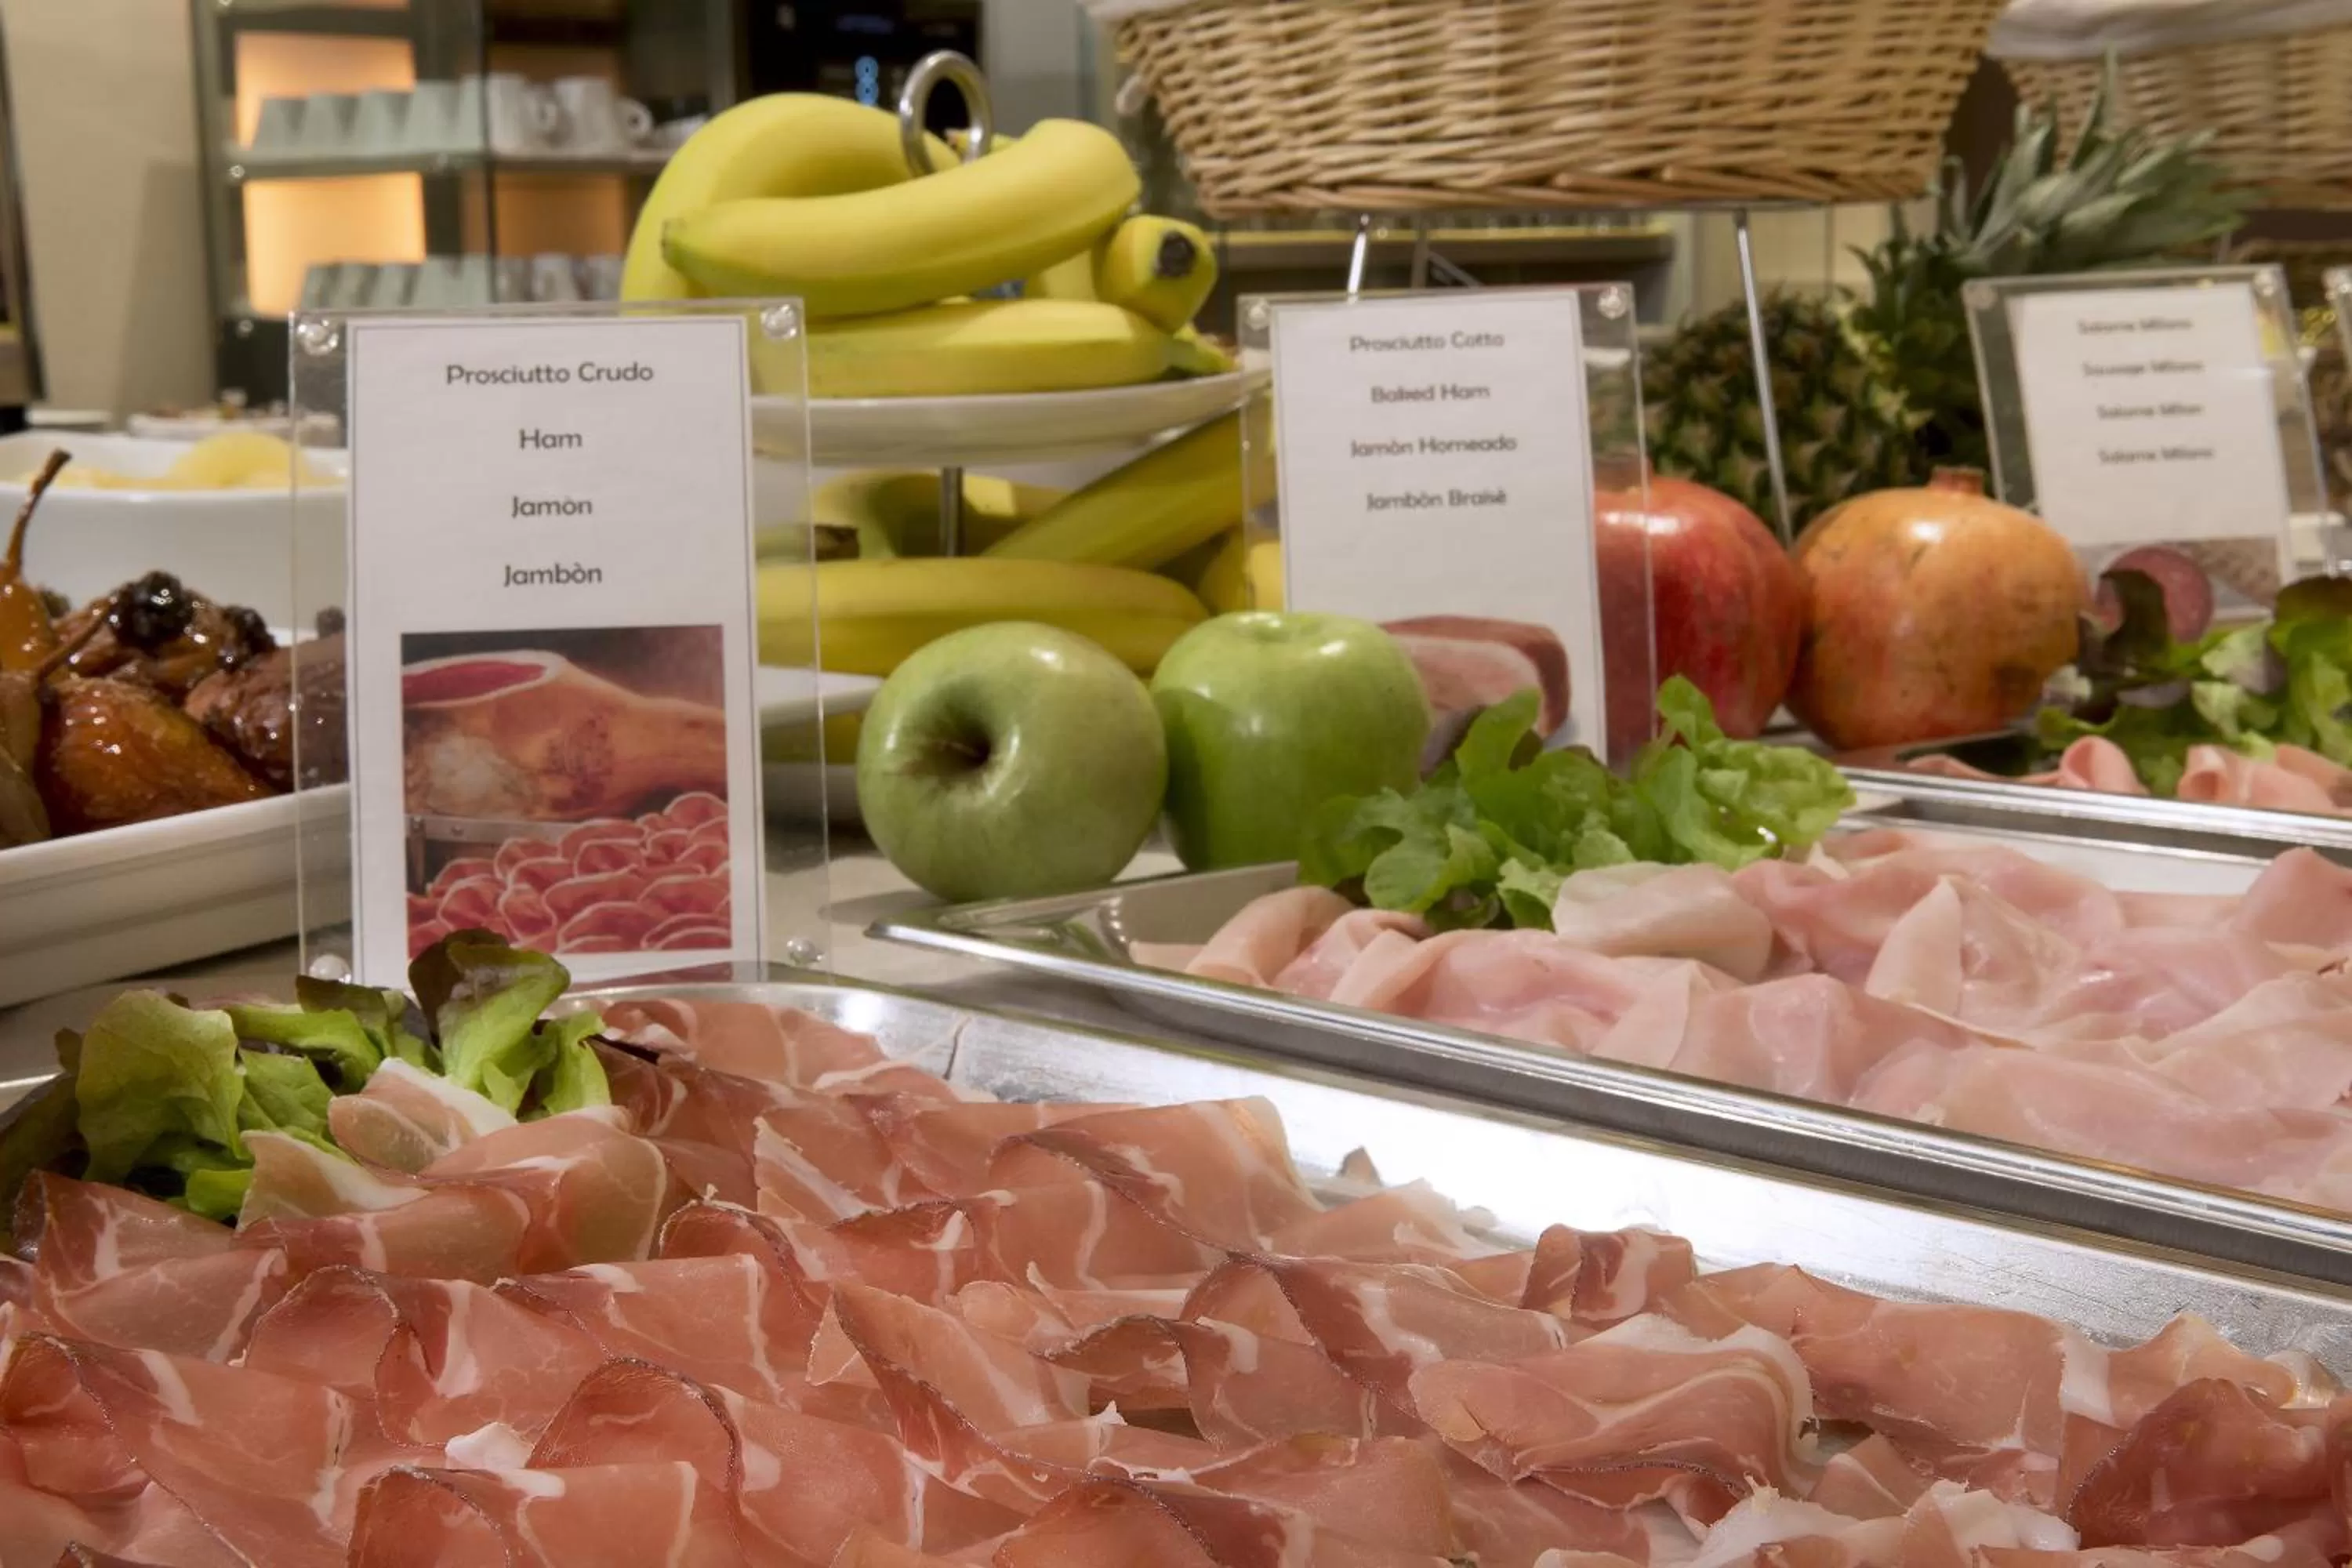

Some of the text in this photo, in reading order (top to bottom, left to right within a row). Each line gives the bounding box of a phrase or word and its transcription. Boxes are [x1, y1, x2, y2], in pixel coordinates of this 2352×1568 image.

[1348, 331, 1505, 353] Prosciutto Cotto
[446, 361, 655, 385] Prosciutto Crudo
[1370, 383, 1490, 403] Baked Ham
[519, 428, 583, 449] Ham
[503, 561, 603, 588] Jambòn
